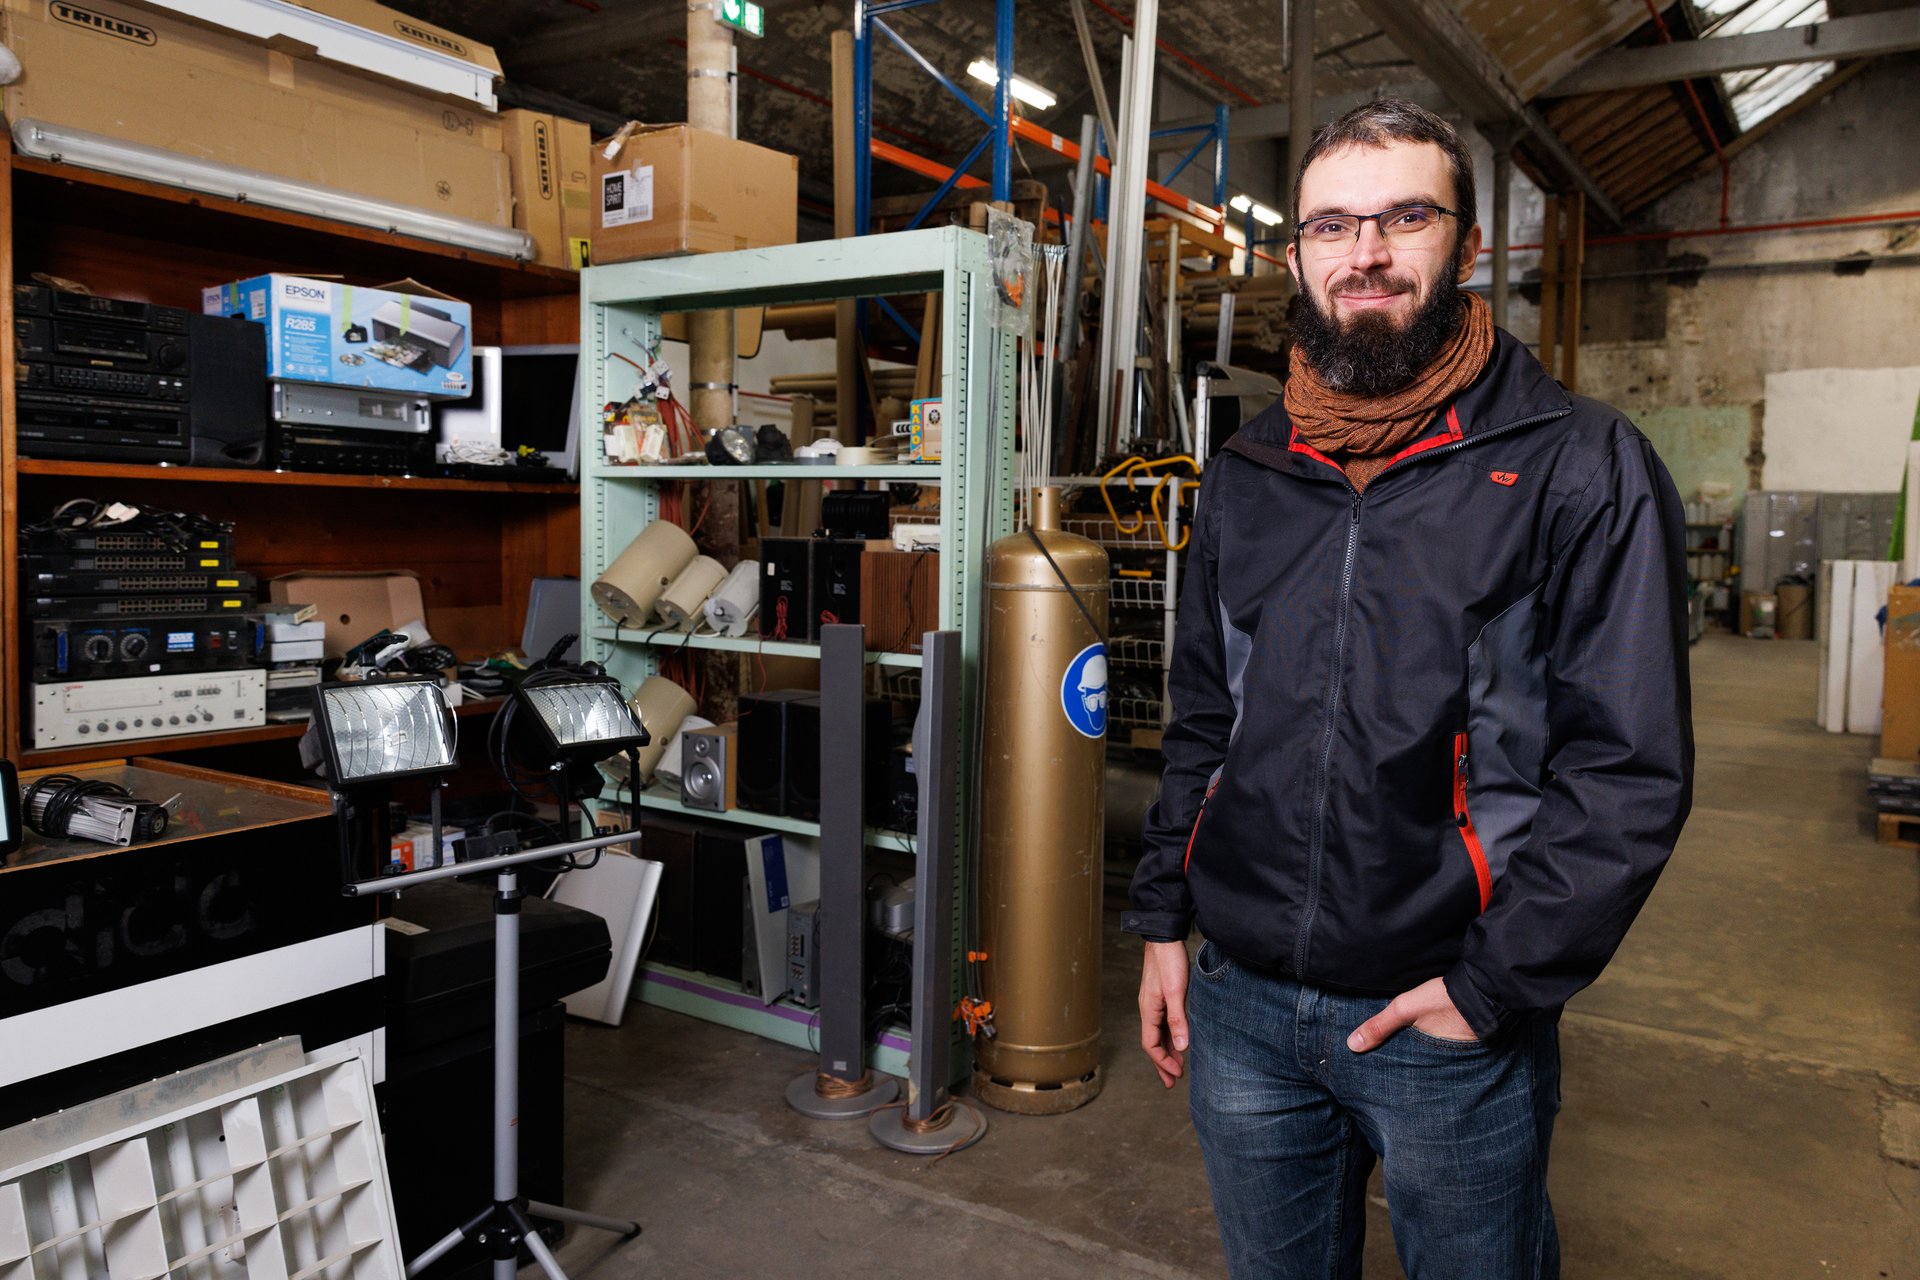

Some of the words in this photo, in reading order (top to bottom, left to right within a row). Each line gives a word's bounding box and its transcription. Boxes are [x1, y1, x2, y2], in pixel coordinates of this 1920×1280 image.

[56, 4, 150, 42] TRILUX
[398, 22, 464, 53] TRILUX
[537, 126, 550, 194] TRILUX
[606, 181, 622, 194] HOME
[606, 192, 622, 207] SPIRIT
[286, 284, 325, 300] EPSON
[911, 404, 921, 446] KAPO
